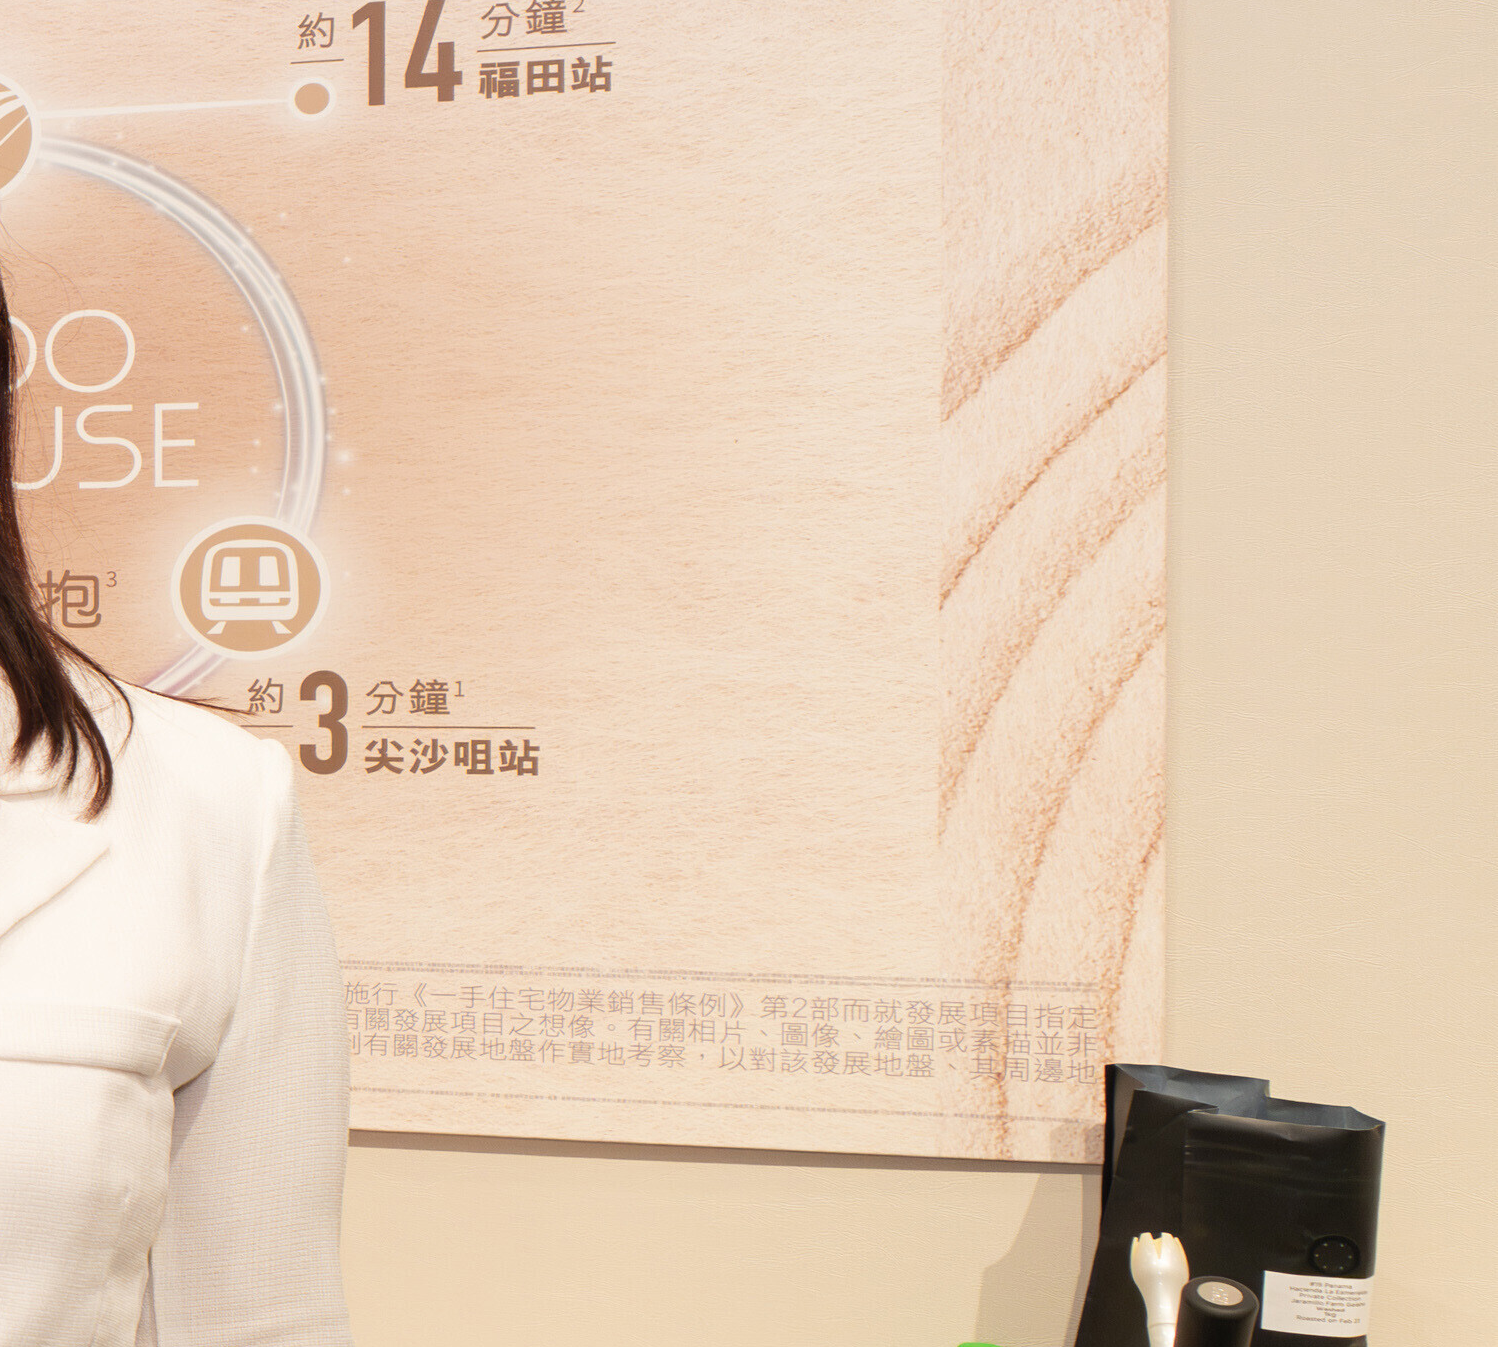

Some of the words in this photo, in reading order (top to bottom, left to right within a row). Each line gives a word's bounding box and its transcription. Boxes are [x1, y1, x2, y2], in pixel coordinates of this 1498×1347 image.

[297, 11, 336, 50] 約
[478, 55, 613, 100] 福田站
[11, 402, 200, 490] USE
[247, 677, 284, 715] 約
[299, 670, 349, 774] 3
[364, 737, 541, 775] 尖沙咀站
